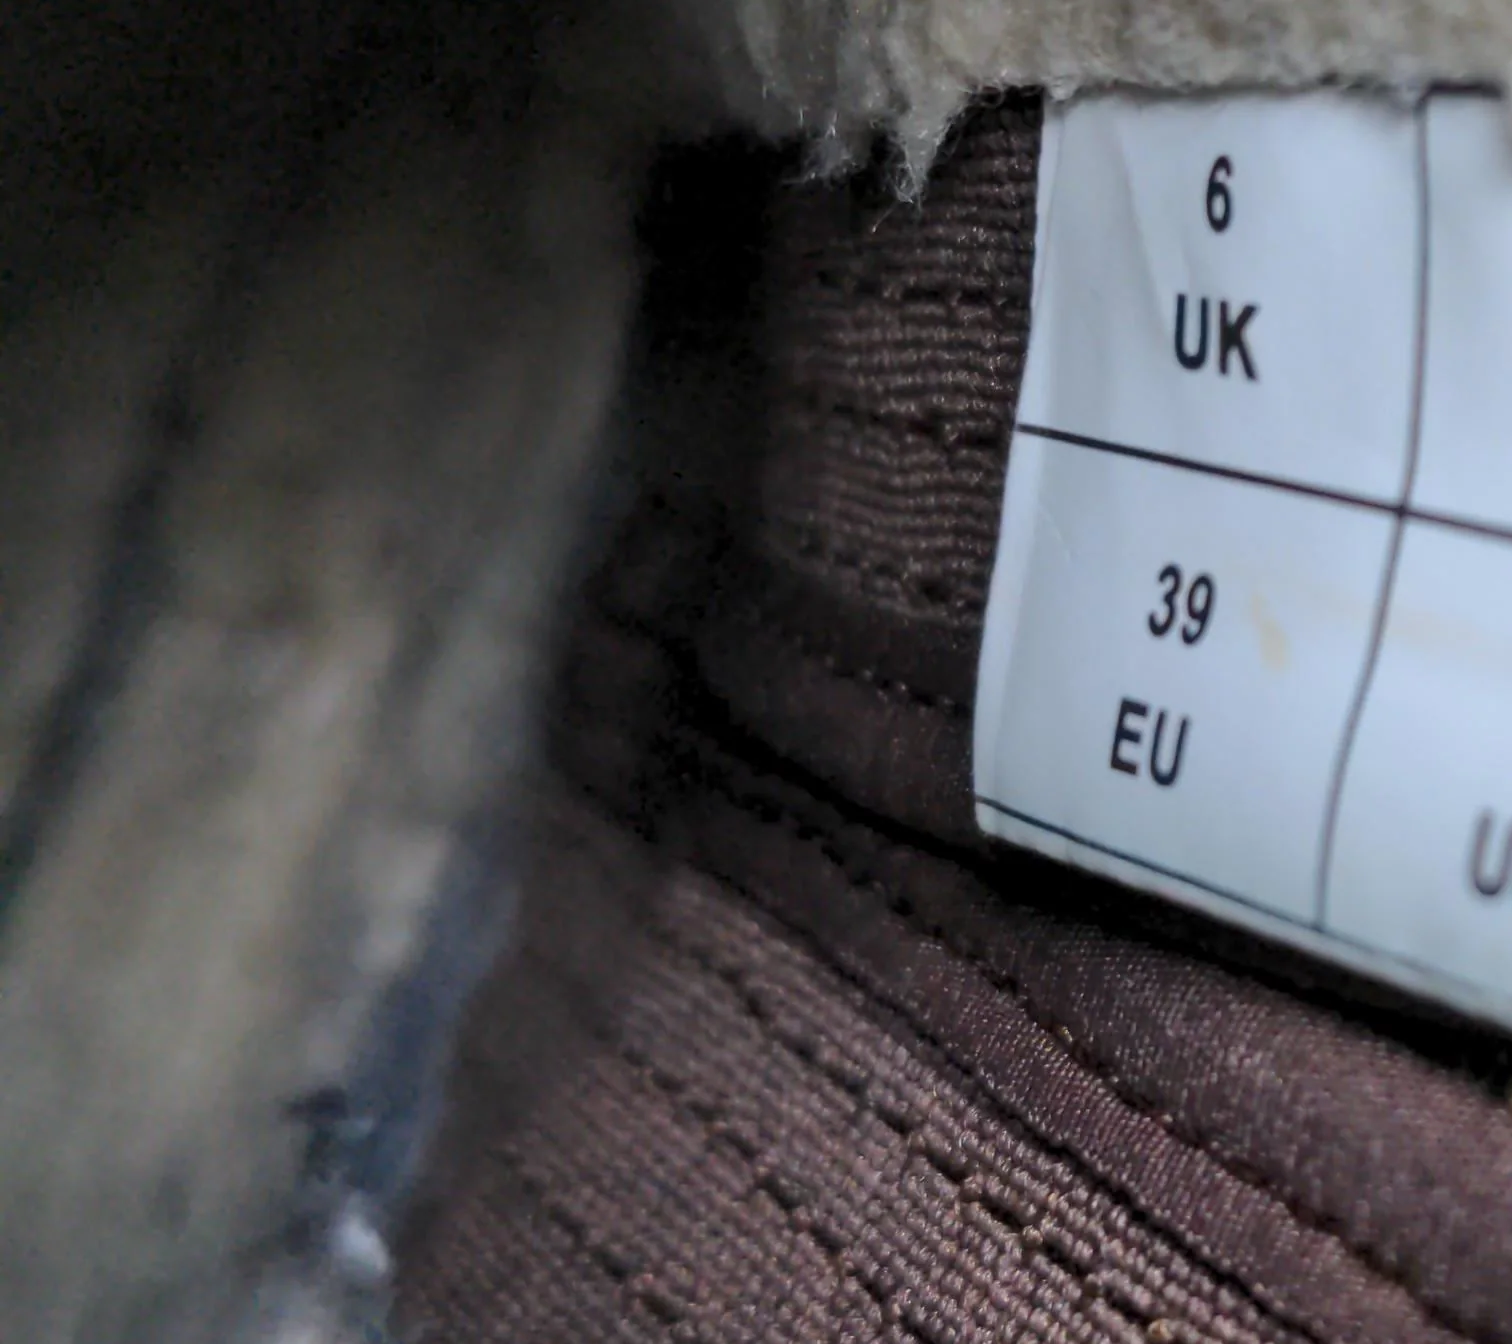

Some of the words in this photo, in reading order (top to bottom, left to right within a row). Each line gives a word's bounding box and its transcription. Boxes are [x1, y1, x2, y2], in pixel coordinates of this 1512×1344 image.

[1203, 154, 1235, 235] 6
[1171, 291, 1260, 383] UK
[1145, 562, 1217, 647] 39
[1107, 696, 1191, 789] EU
